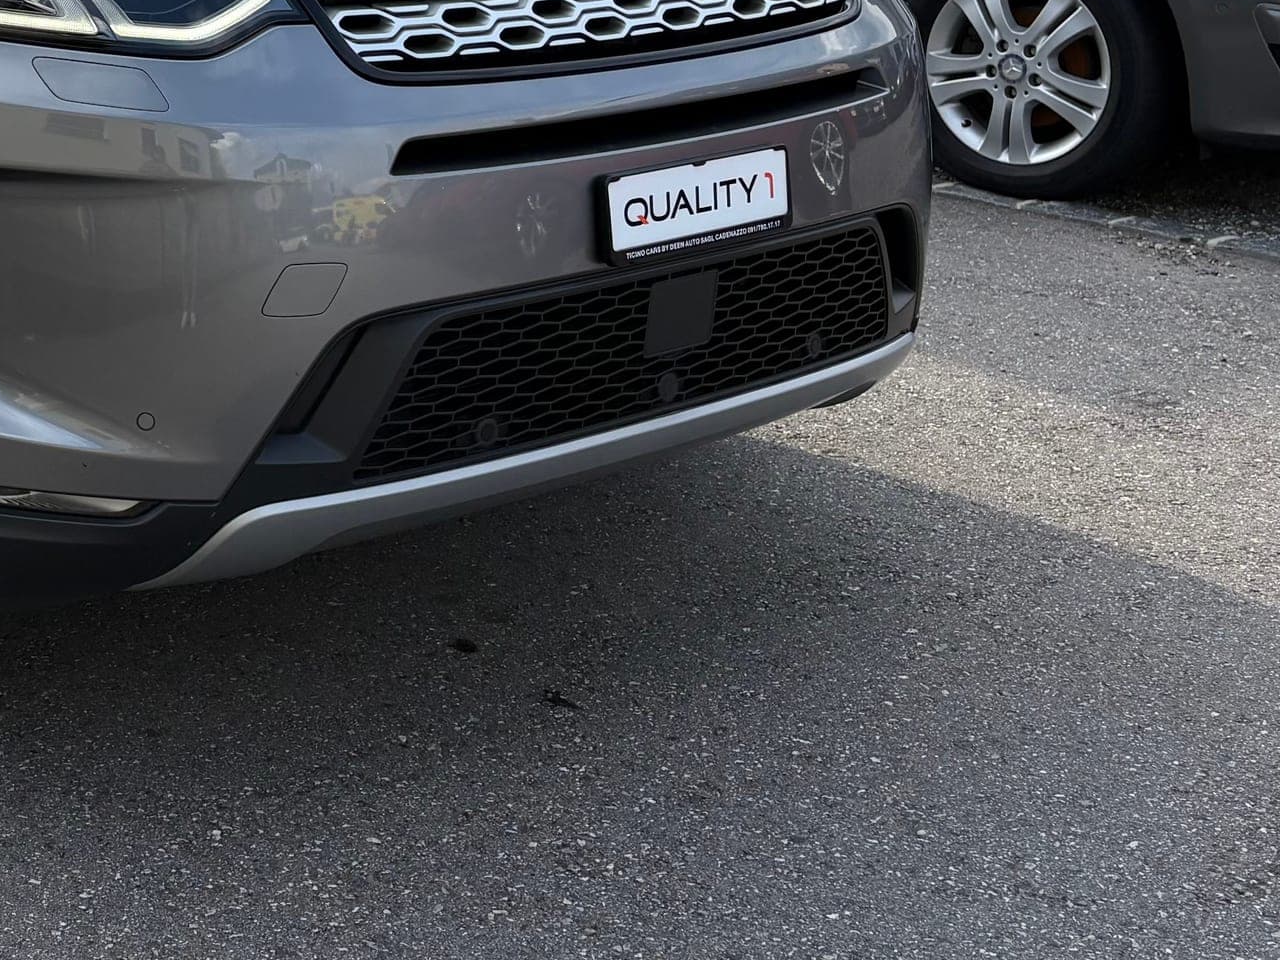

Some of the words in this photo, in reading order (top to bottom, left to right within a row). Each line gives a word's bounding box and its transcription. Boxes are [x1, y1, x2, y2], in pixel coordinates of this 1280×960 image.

[624, 174, 758, 227] QUALITY
[626, 249, 646, 259] TICINO
[646, 246, 661, 256] CARS
[662, 244, 670, 252] BY
[670, 240, 685, 251] DEEN
[685, 238, 700, 248] AUTO
